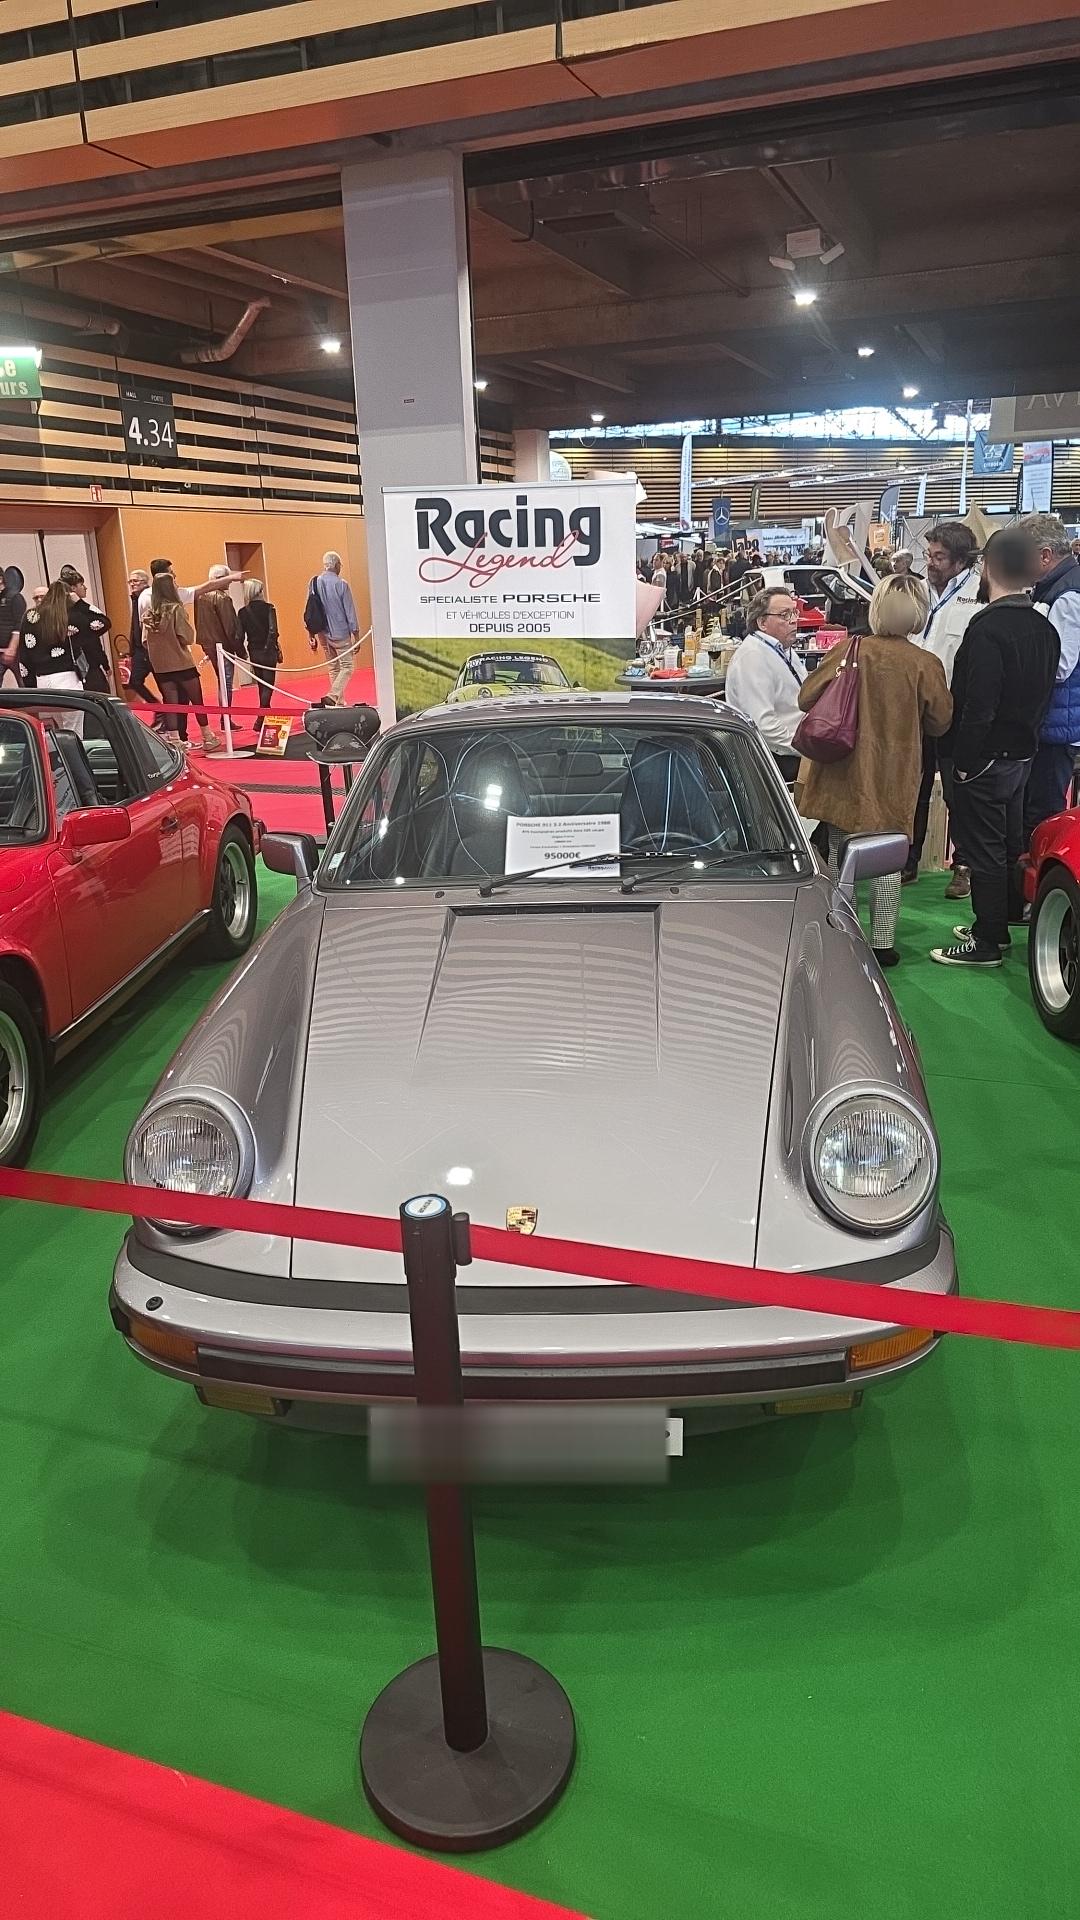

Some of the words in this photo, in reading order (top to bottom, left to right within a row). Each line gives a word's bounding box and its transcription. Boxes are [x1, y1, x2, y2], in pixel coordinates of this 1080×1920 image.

[151, 394, 164, 403] PORTE
[128, 416, 174, 449] 4.34
[415, 495, 601, 567] Racing
[418, 529, 580, 589] Legend
[420, 595, 498, 604] SPECIALISTE
[502, 593, 601, 603] PORSCHE
[446, 611, 457, 620] ET
[458, 609, 511, 620] VÉHICULES
[512, 610, 575, 620] D'EXCEPTION
[469, 623, 514, 633] DEPUIS
[517, 623, 551, 633] 2005
[513, 655, 549, 663] LEGEND
[544, 851, 581, 860] 95000€
